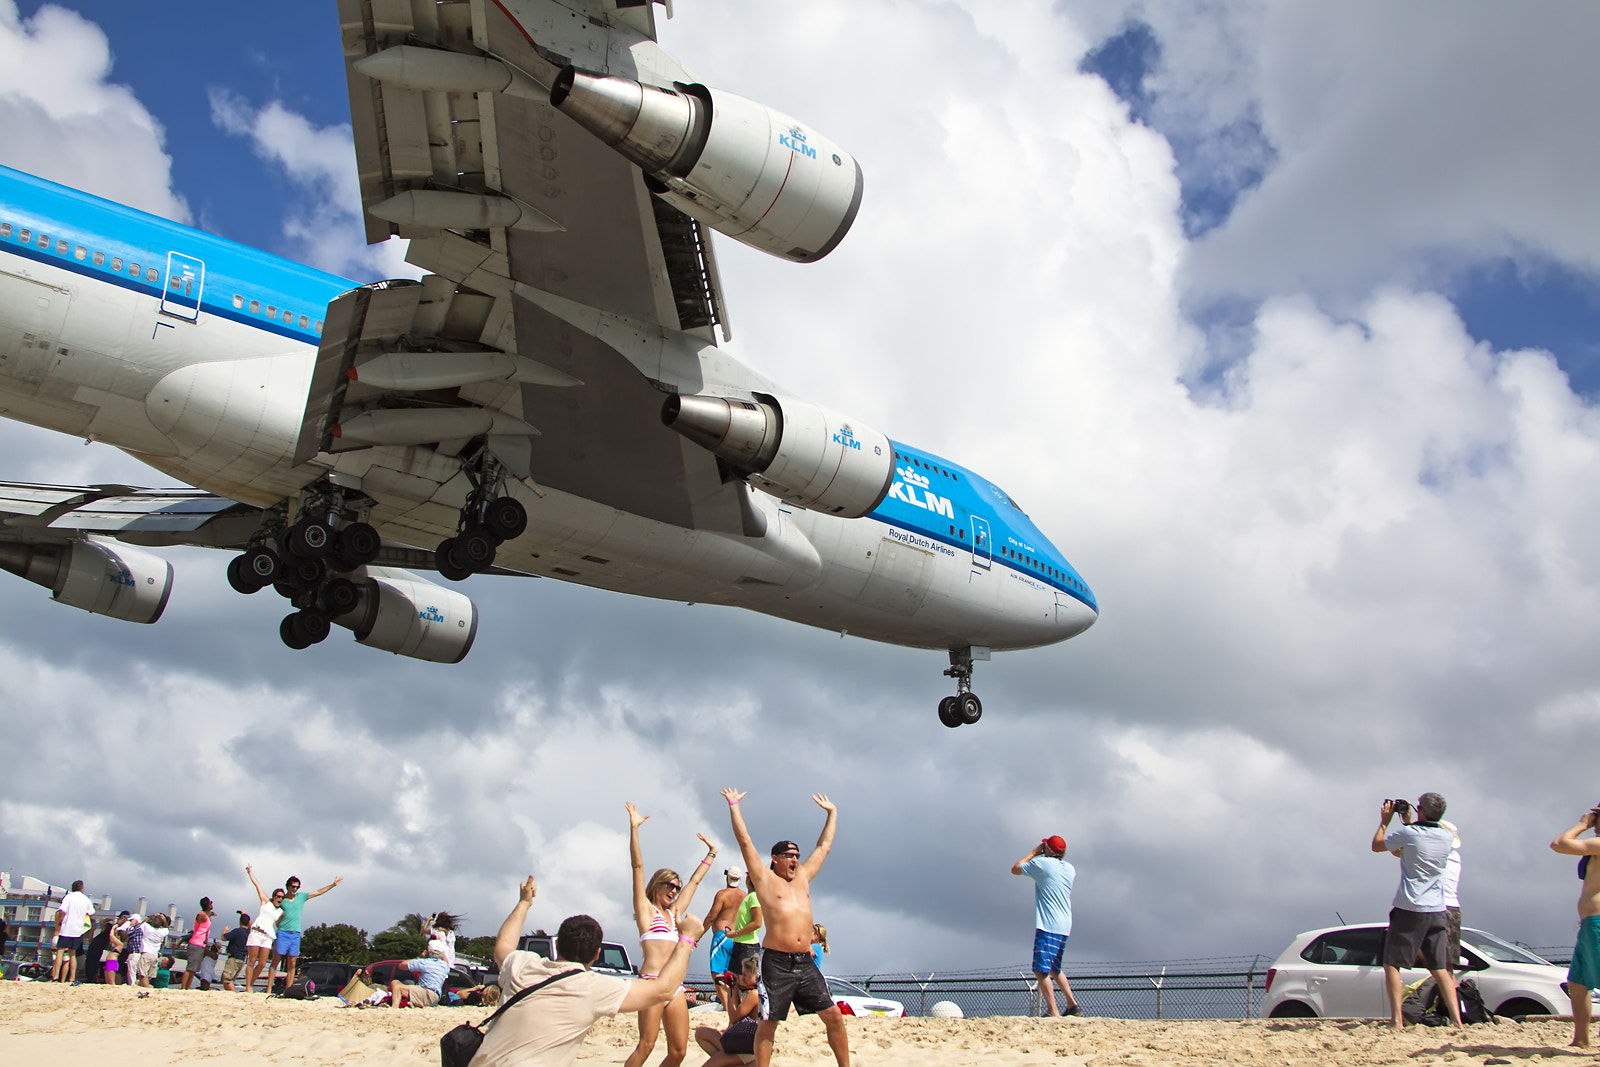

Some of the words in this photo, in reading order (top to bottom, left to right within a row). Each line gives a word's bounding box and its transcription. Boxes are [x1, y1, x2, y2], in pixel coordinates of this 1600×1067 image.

[779, 133, 816, 159] KLM
[833, 433, 860, 450] KLM
[889, 481, 954, 519] KLM
[889, 528, 908, 541] Royal
[909, 535, 929, 548] Dutch
[930, 543, 955, 557] Airlines
[110, 575, 136, 587] KLM
[419, 611, 444, 623] KLM
